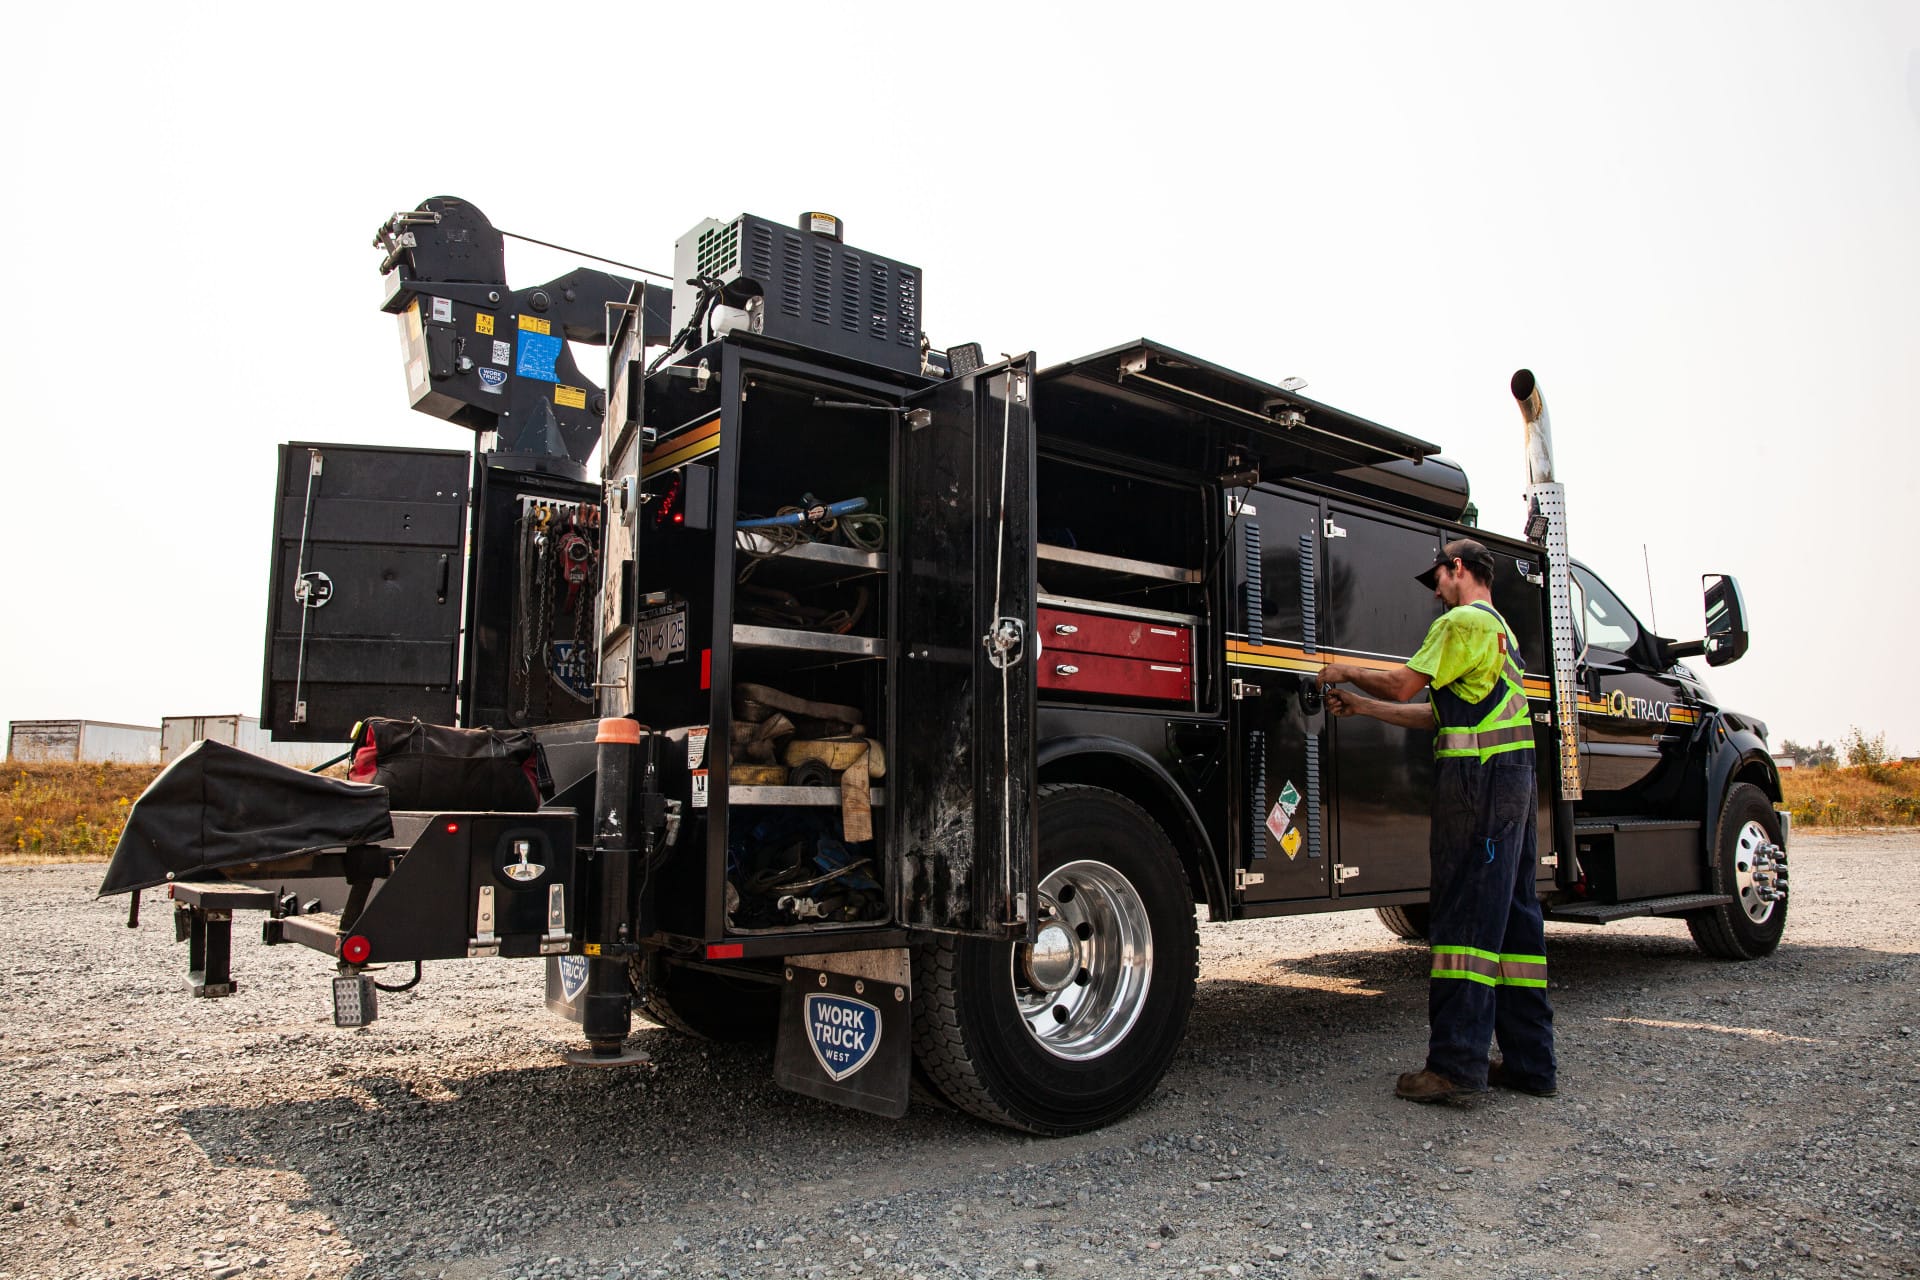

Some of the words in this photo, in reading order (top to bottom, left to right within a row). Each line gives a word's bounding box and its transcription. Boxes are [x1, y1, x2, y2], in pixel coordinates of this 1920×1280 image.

[483, 373, 502, 382] TRUCK
[1607, 689, 1670, 723] LONETRACK
[563, 961, 586, 981] TRUCK
[817, 1002, 865, 1030] WORK
[814, 1022, 866, 1051] TRUCK
[825, 1048, 850, 1063] WEST
